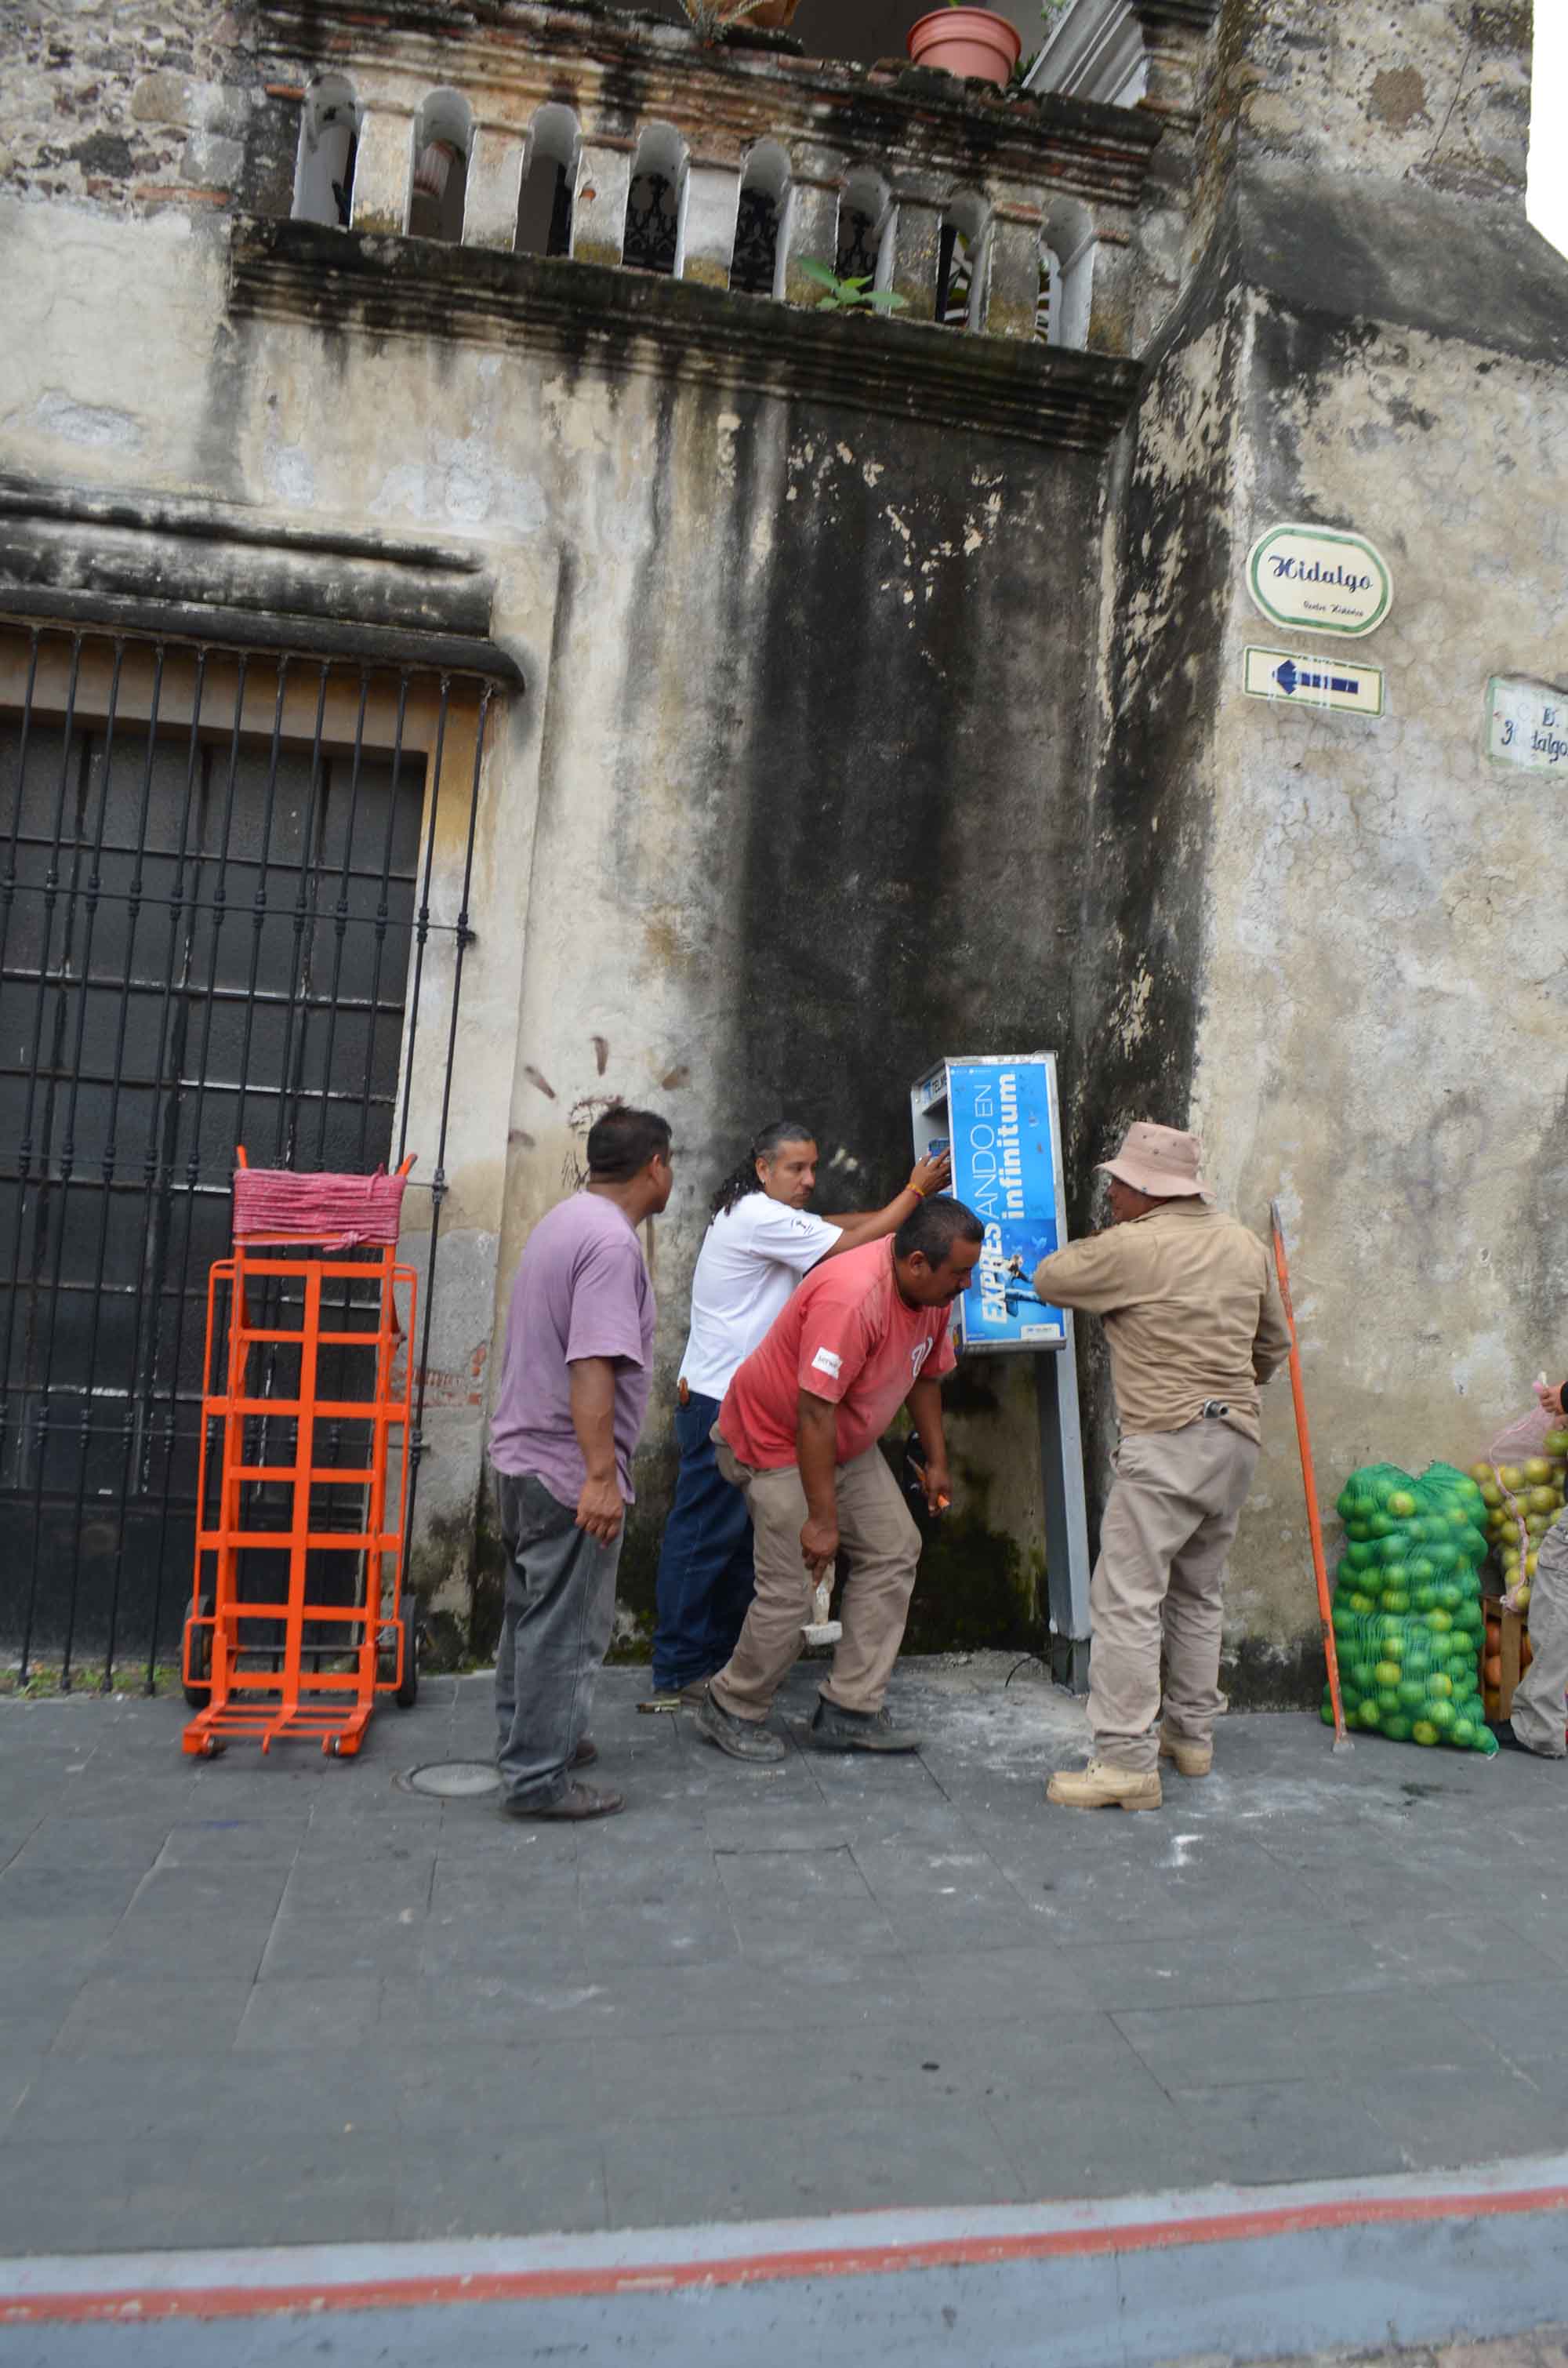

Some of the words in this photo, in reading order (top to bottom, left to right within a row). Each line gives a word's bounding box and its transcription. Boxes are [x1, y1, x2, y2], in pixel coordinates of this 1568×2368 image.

[1268, 555, 1373, 593] Hidalgo
[974, 1084, 993, 1117] EN
[996, 1073, 1025, 1221] infinitum
